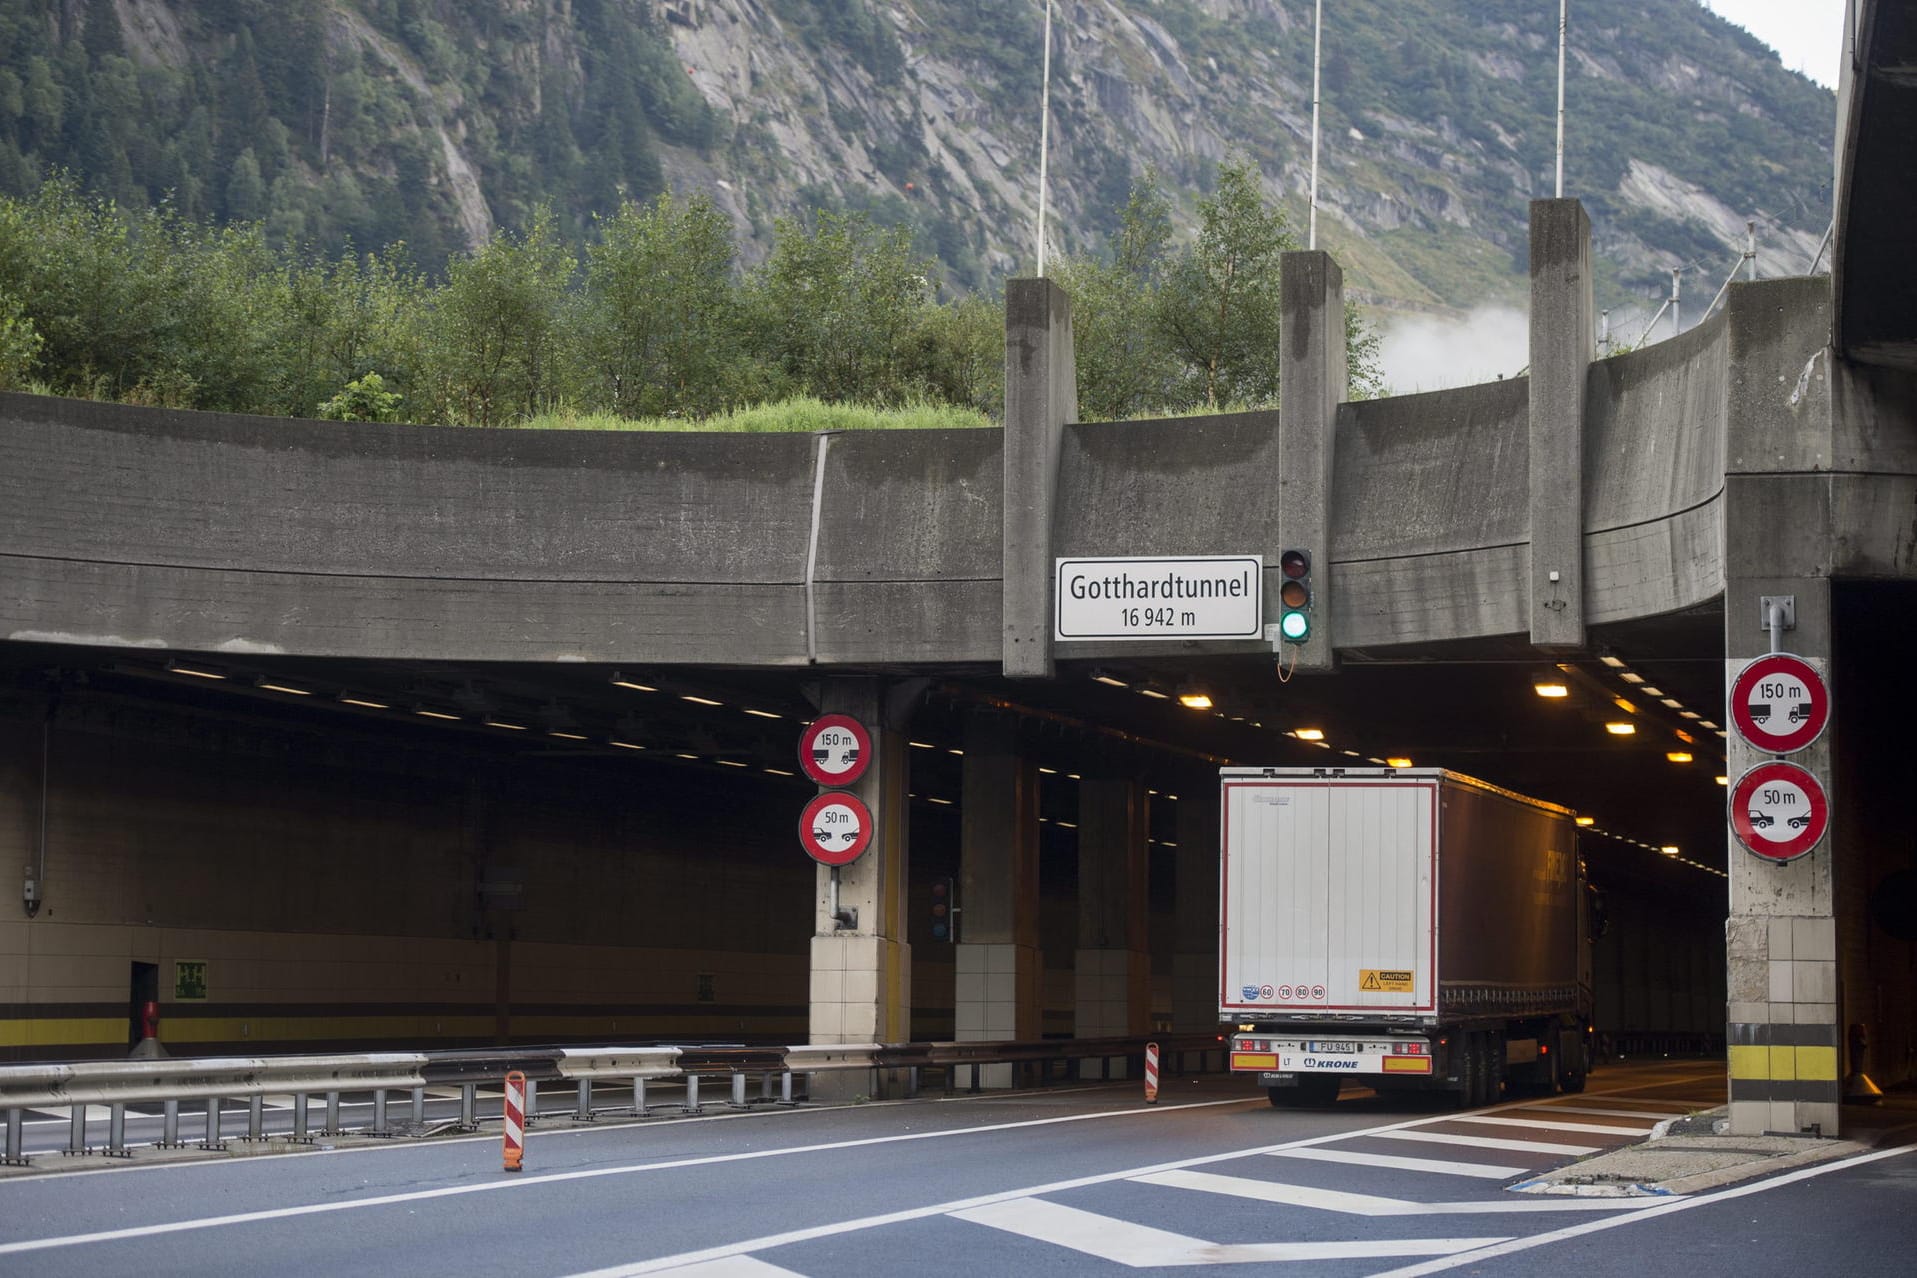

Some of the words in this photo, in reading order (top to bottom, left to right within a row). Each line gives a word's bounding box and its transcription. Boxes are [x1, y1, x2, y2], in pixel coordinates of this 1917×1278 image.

[1070, 570, 1248, 600] Gotthardtunnel
[1121, 608, 1139, 627] 16
[1144, 607, 1175, 627] 942
[1181, 611, 1196, 626] m
[1760, 683, 1784, 699] 150
[1788, 685, 1801, 699] m
[821, 734, 839, 746] 150
[842, 735, 852, 746] m
[1764, 790, 1780, 805] 50
[1783, 792, 1796, 804] m
[825, 811, 838, 824] 50
[839, 813, 849, 824] m
[1262, 988, 1272, 996] 60
[1281, 988, 1290, 996] 70
[1297, 988, 1307, 996] 80
[1313, 988, 1323, 996] 90
[1283, 1058, 1291, 1066] LT
[1317, 1061, 1359, 1069] KRONE
